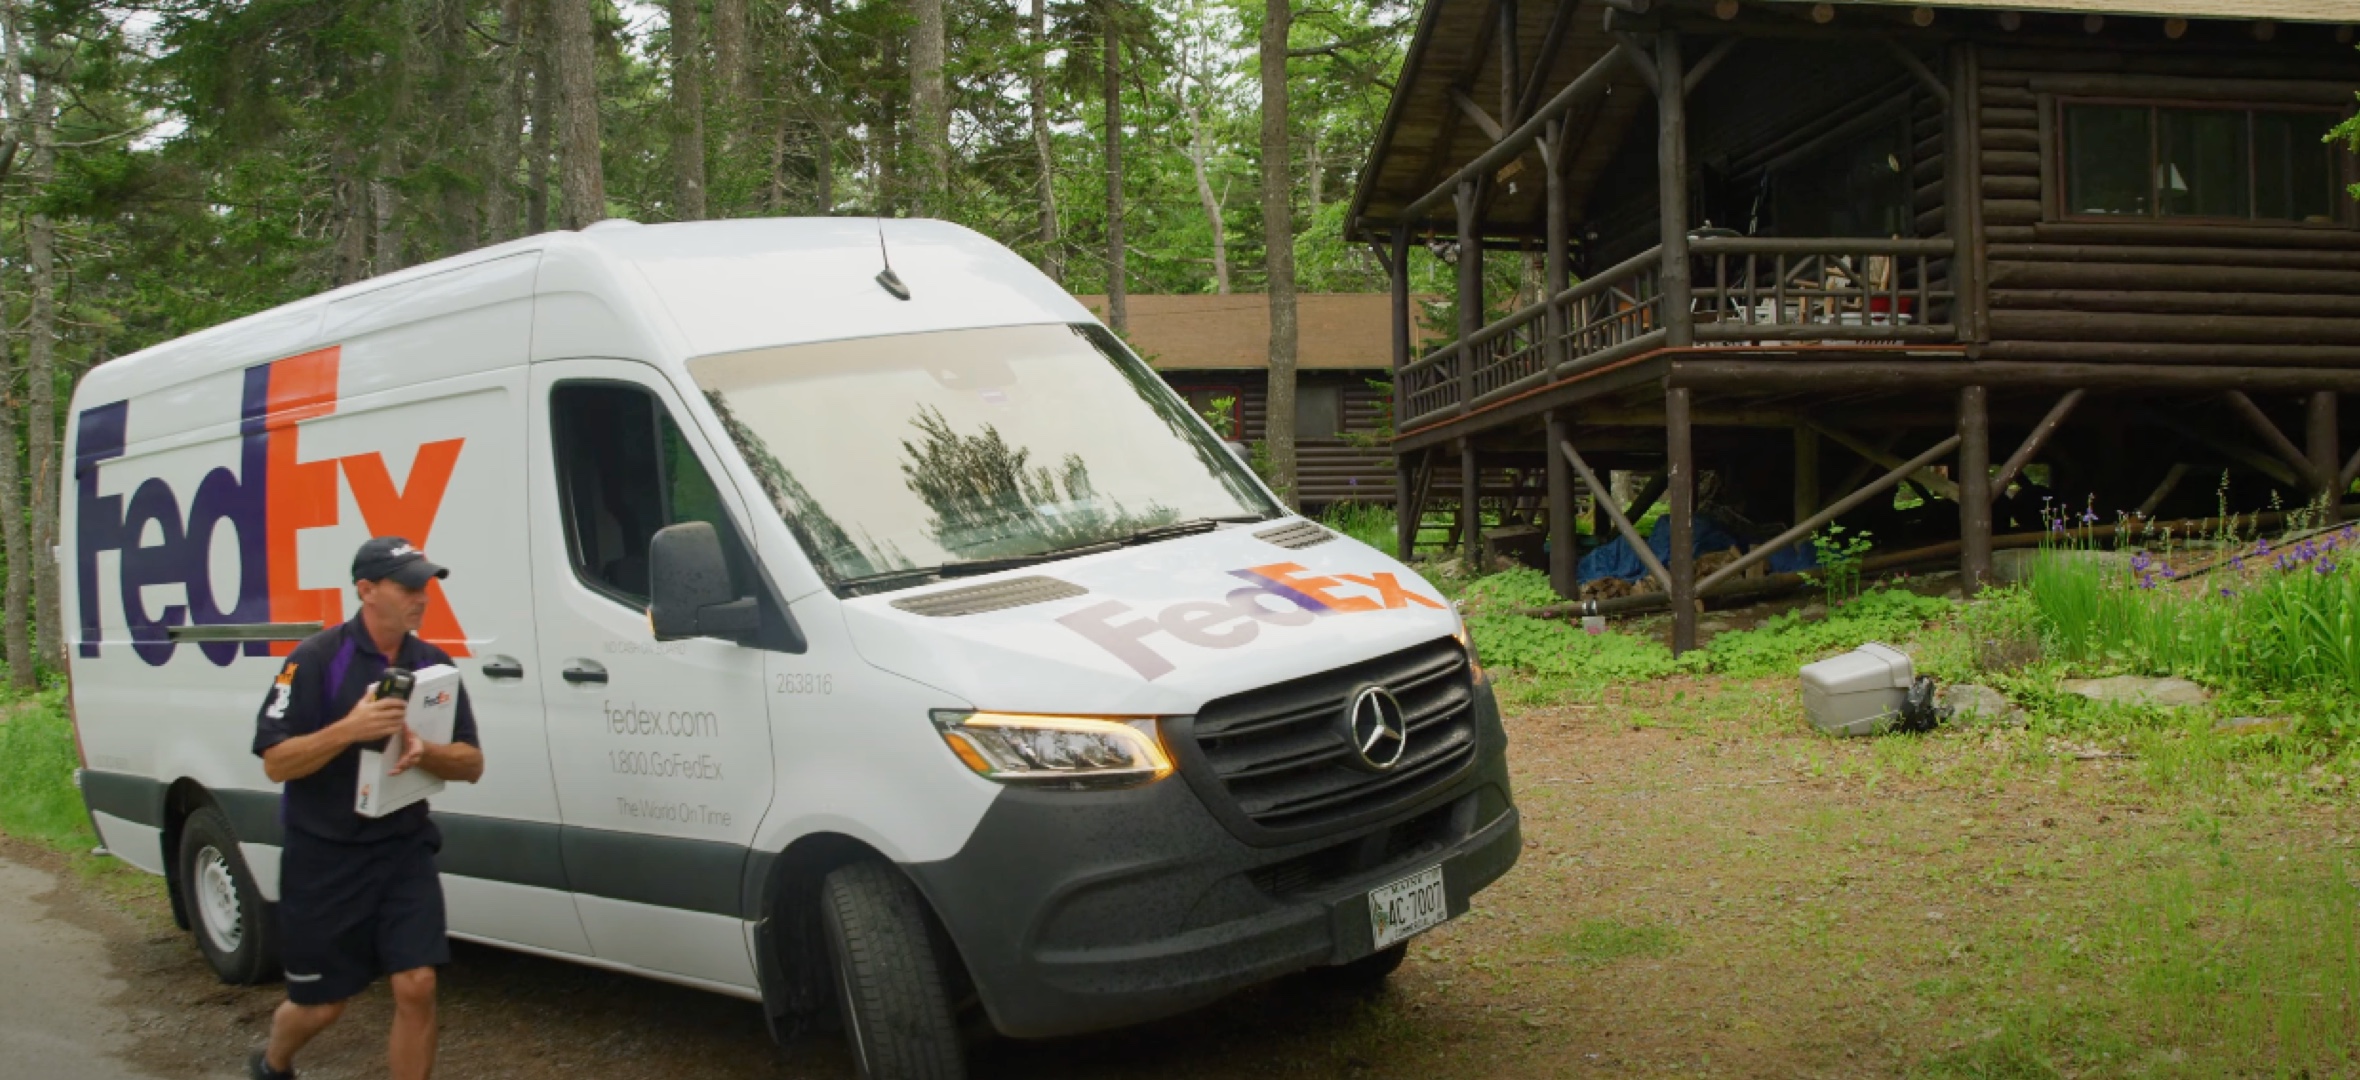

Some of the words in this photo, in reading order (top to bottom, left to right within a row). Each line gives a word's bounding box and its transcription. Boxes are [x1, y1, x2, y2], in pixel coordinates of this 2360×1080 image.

[76, 345, 473, 667] FedEx
[1055, 561, 1448, 682] FedEx
[776, 673, 833, 695] 263816
[604, 700, 718, 737] fedex.com
[608, 749, 724, 780] 1.800.GoFedEx
[616, 796, 638, 817] The
[639, 798, 677, 821] World
[679, 801, 698, 823] On
[698, 804, 732, 827] Time
